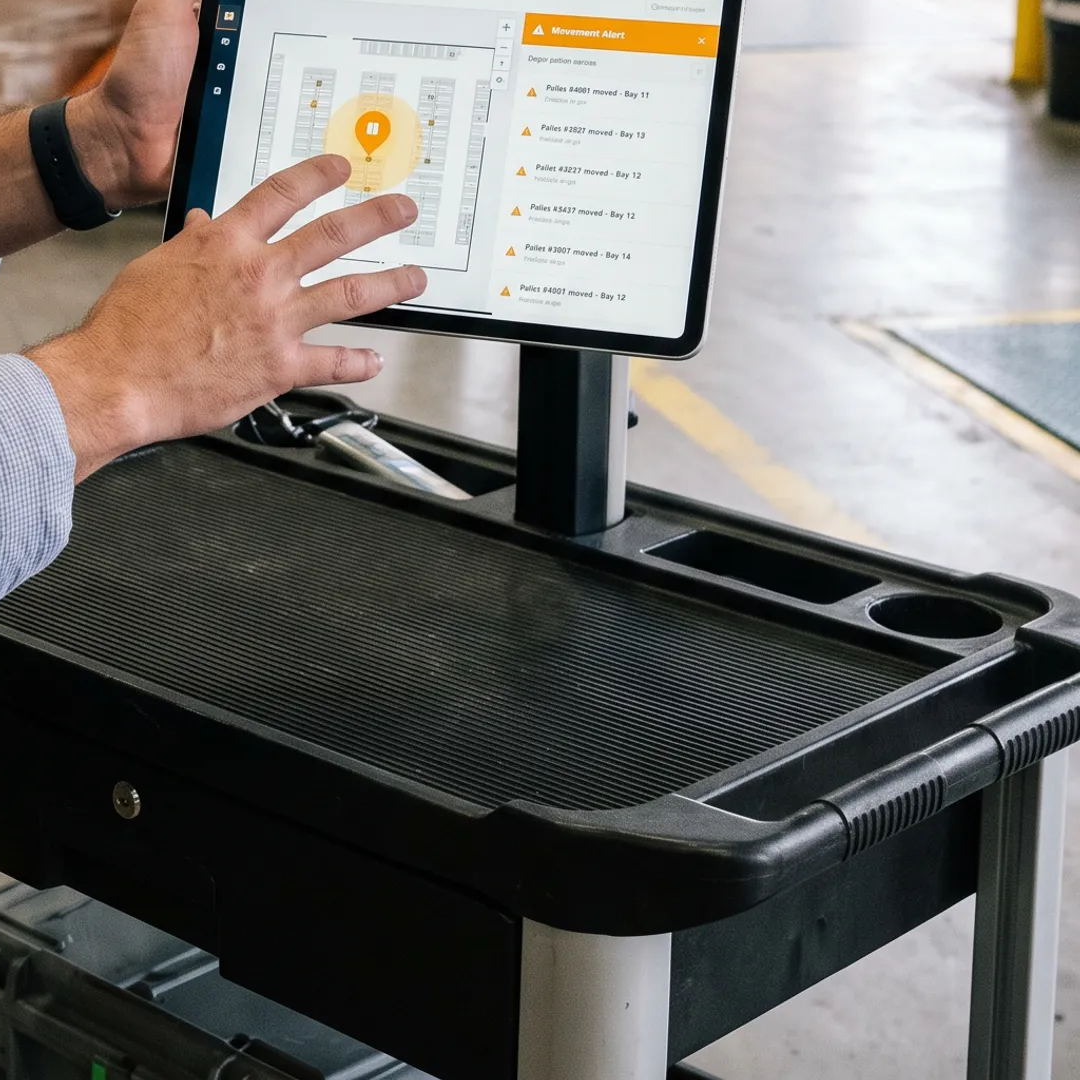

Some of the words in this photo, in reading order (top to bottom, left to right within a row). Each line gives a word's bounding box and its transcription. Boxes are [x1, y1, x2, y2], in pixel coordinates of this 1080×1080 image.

[551, 26, 600, 38] Movement
[602, 30, 625, 39] Alert
[592, 89, 618, 97] moved
[624, 90, 638, 99] Bay
[640, 91, 650, 99] 11
[587, 128, 614, 137] moved
[619, 130, 633, 140] Bay
[636, 131, 646, 139] 13
[583, 169, 609, 177] moved
[615, 170, 630, 180] Bay
[632, 171, 642, 180] 12
[577, 208, 603, 217] moved
[610, 210, 624, 220] Bay
[626, 212, 636, 220] 12
[572, 249, 599, 258] moved
[605, 251, 620, 261] Bay
[621, 252, 631, 260] 14
[567, 289, 593, 298] moved
[600, 292, 615, 302] Bay
[616, 293, 627, 301] 12
